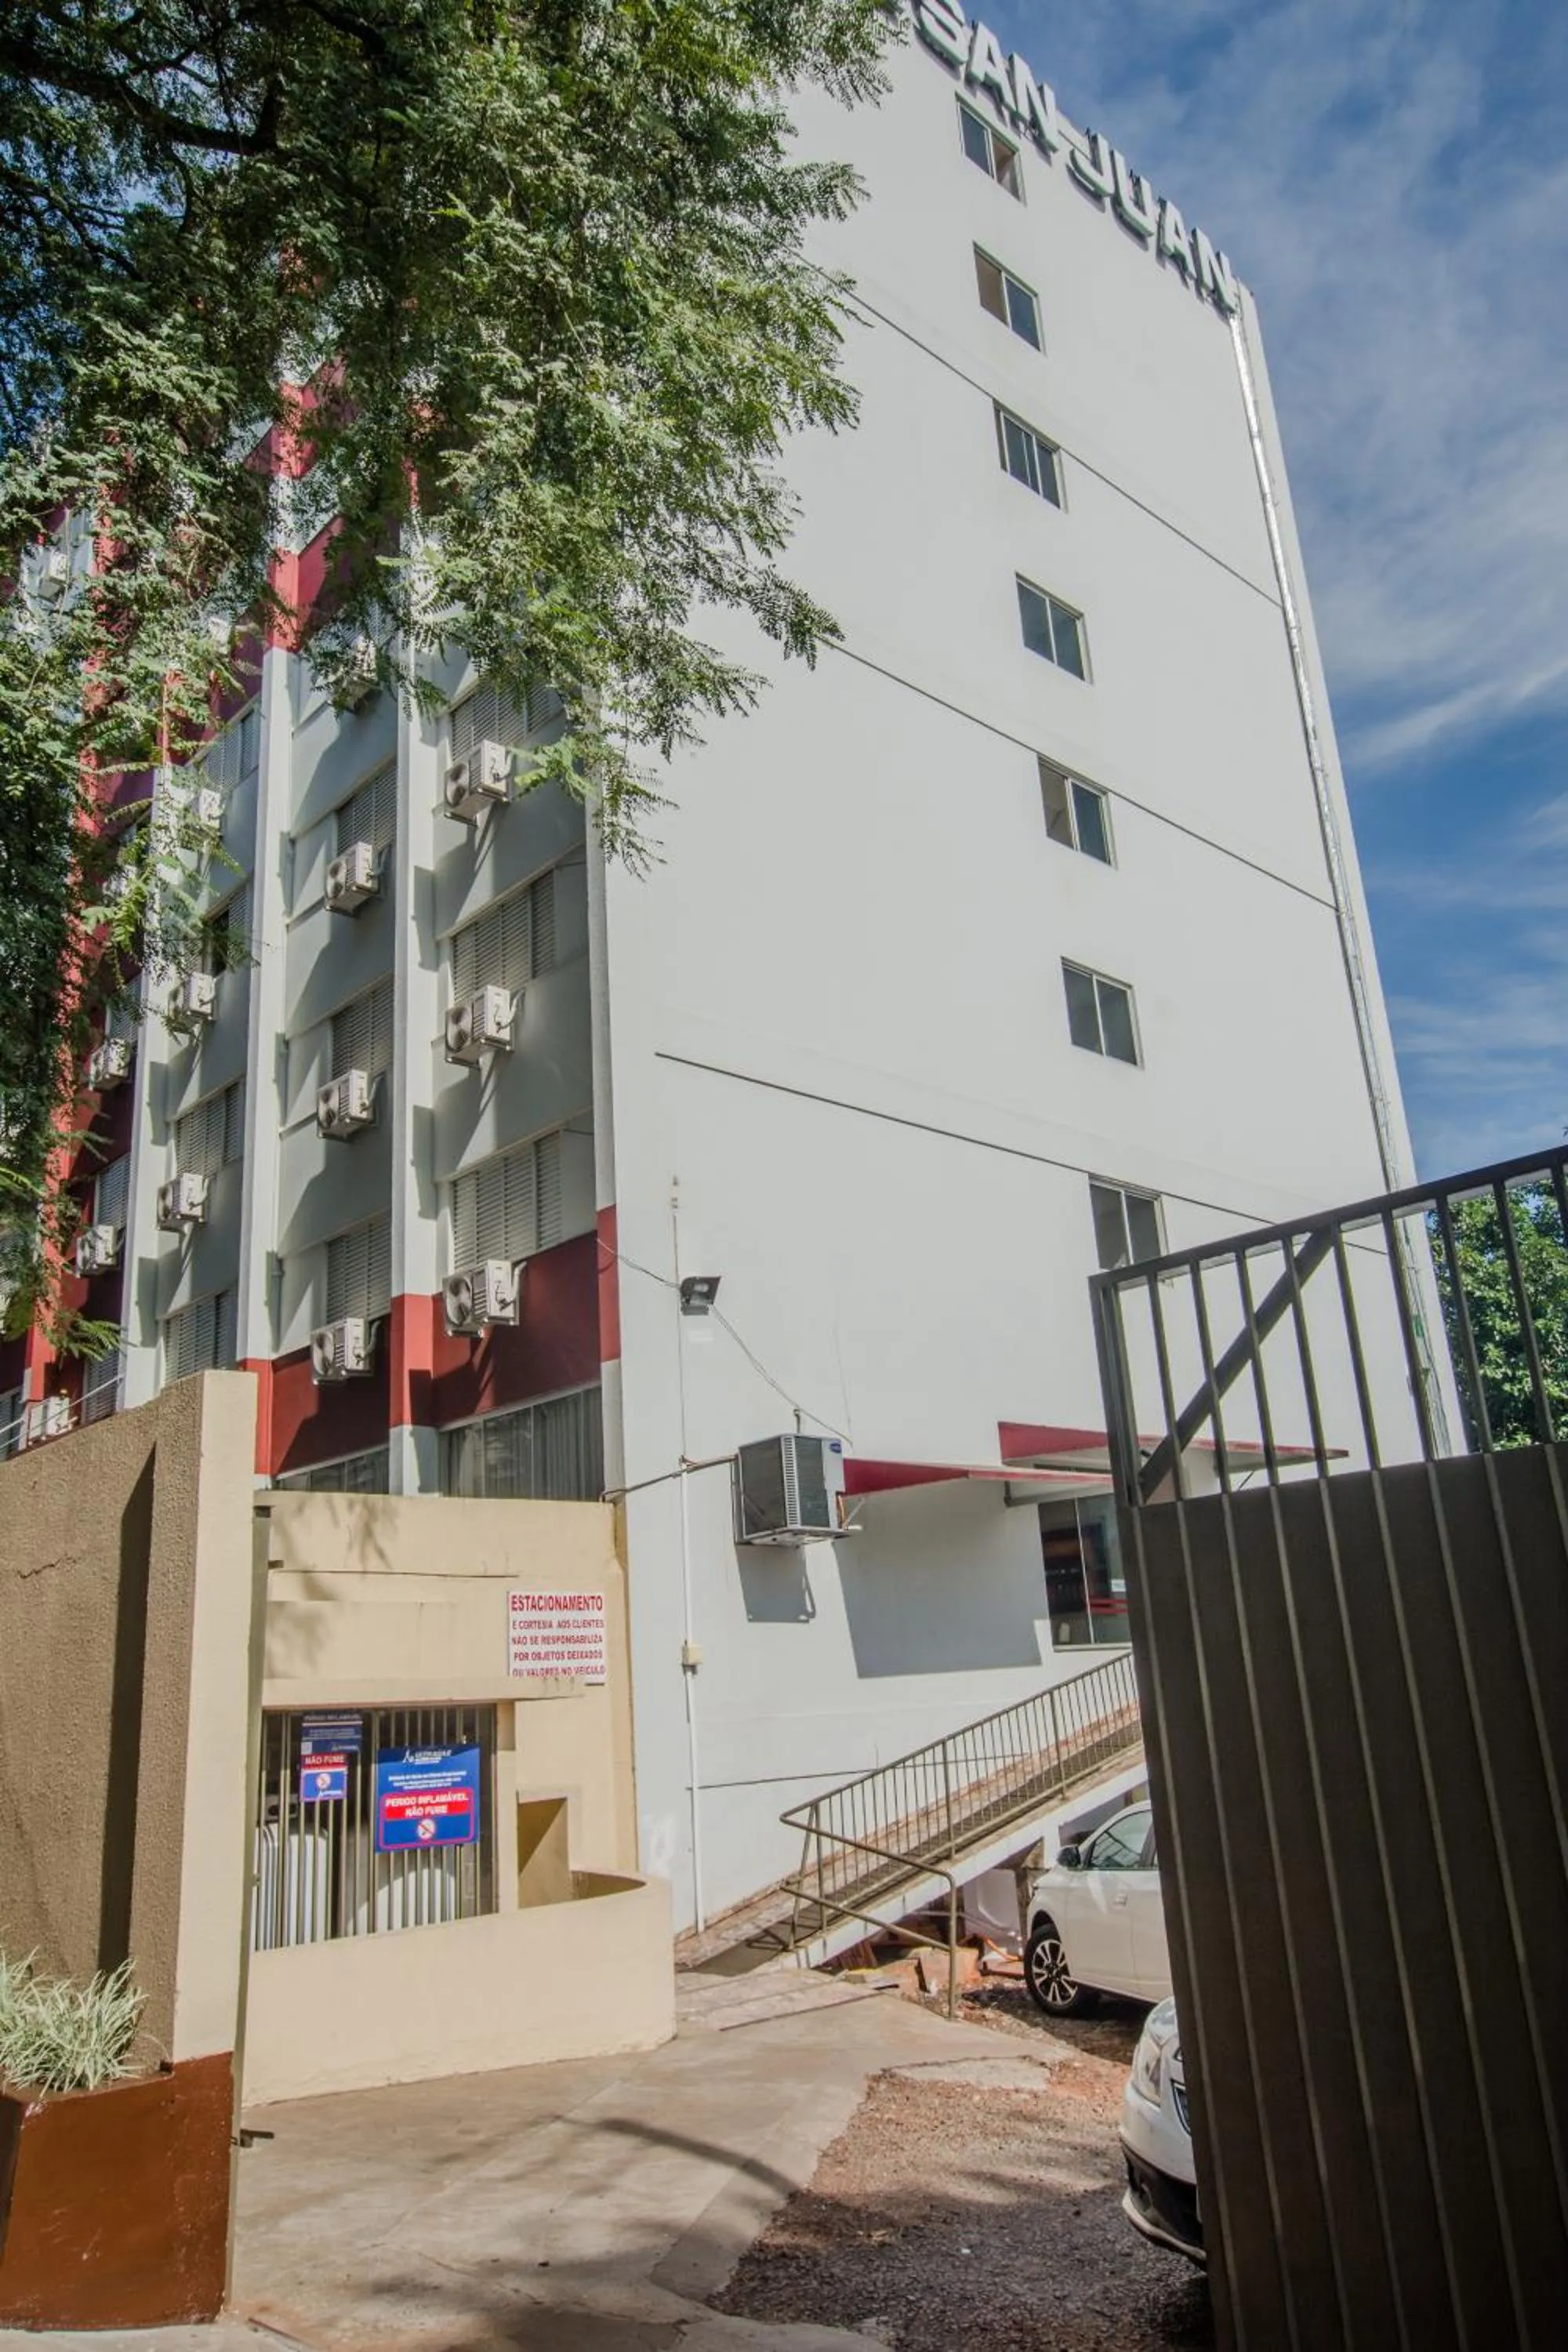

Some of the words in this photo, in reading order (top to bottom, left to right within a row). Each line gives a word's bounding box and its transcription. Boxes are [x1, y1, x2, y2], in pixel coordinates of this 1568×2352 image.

[916, 0, 1058, 151] SAN
[1069, 130, 1236, 314] JUAN
[511, 1595, 603, 1611] ESTACIONAMENTO
[519, 1619, 553, 1630] CORTESIA
[557, 1619, 571, 1629] AOS
[572, 1618, 604, 1628] CLIENTES
[530, 1635, 539, 1646] SE
[541, 1634, 603, 1645] RESPONSABILIZA
[514, 1651, 529, 1661] POR
[531, 1650, 564, 1661] OBJETOS
[567, 1649, 603, 1660] DEIXADOS
